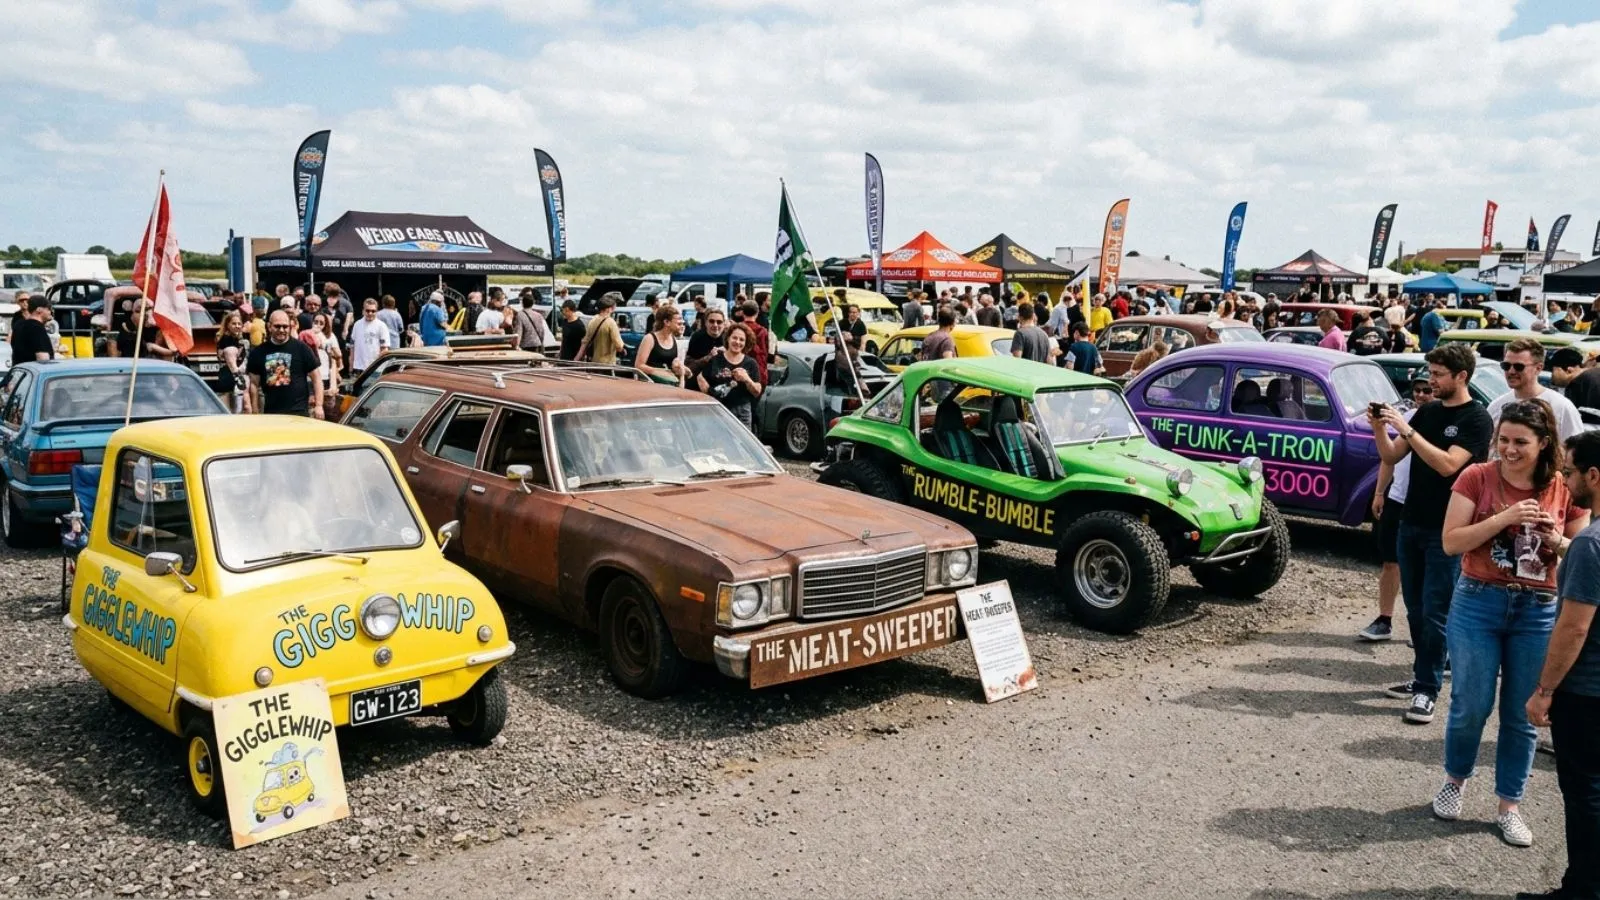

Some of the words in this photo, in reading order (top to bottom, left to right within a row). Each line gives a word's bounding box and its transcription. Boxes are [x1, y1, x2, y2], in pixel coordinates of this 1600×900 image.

[355, 226, 405, 246] WEIRD
[1151, 416, 1174, 432] THE
[1174, 423, 1334, 463] FUNK-A-TRON
[901, 463, 917, 477] THE
[914, 473, 1055, 535] RUMBLE-BUMBLE
[1265, 468, 1329, 498] 3000
[83, 583, 177, 665] GIGGLEWHIP
[277, 604, 310, 625] THE
[756, 638, 785, 663] THE
[788, 605, 958, 674] MEAT-SWEEPER
[248, 692, 291, 717] THE
[354, 688, 419, 721] GW-123
[224, 715, 332, 763] GIGGLEWHIP
